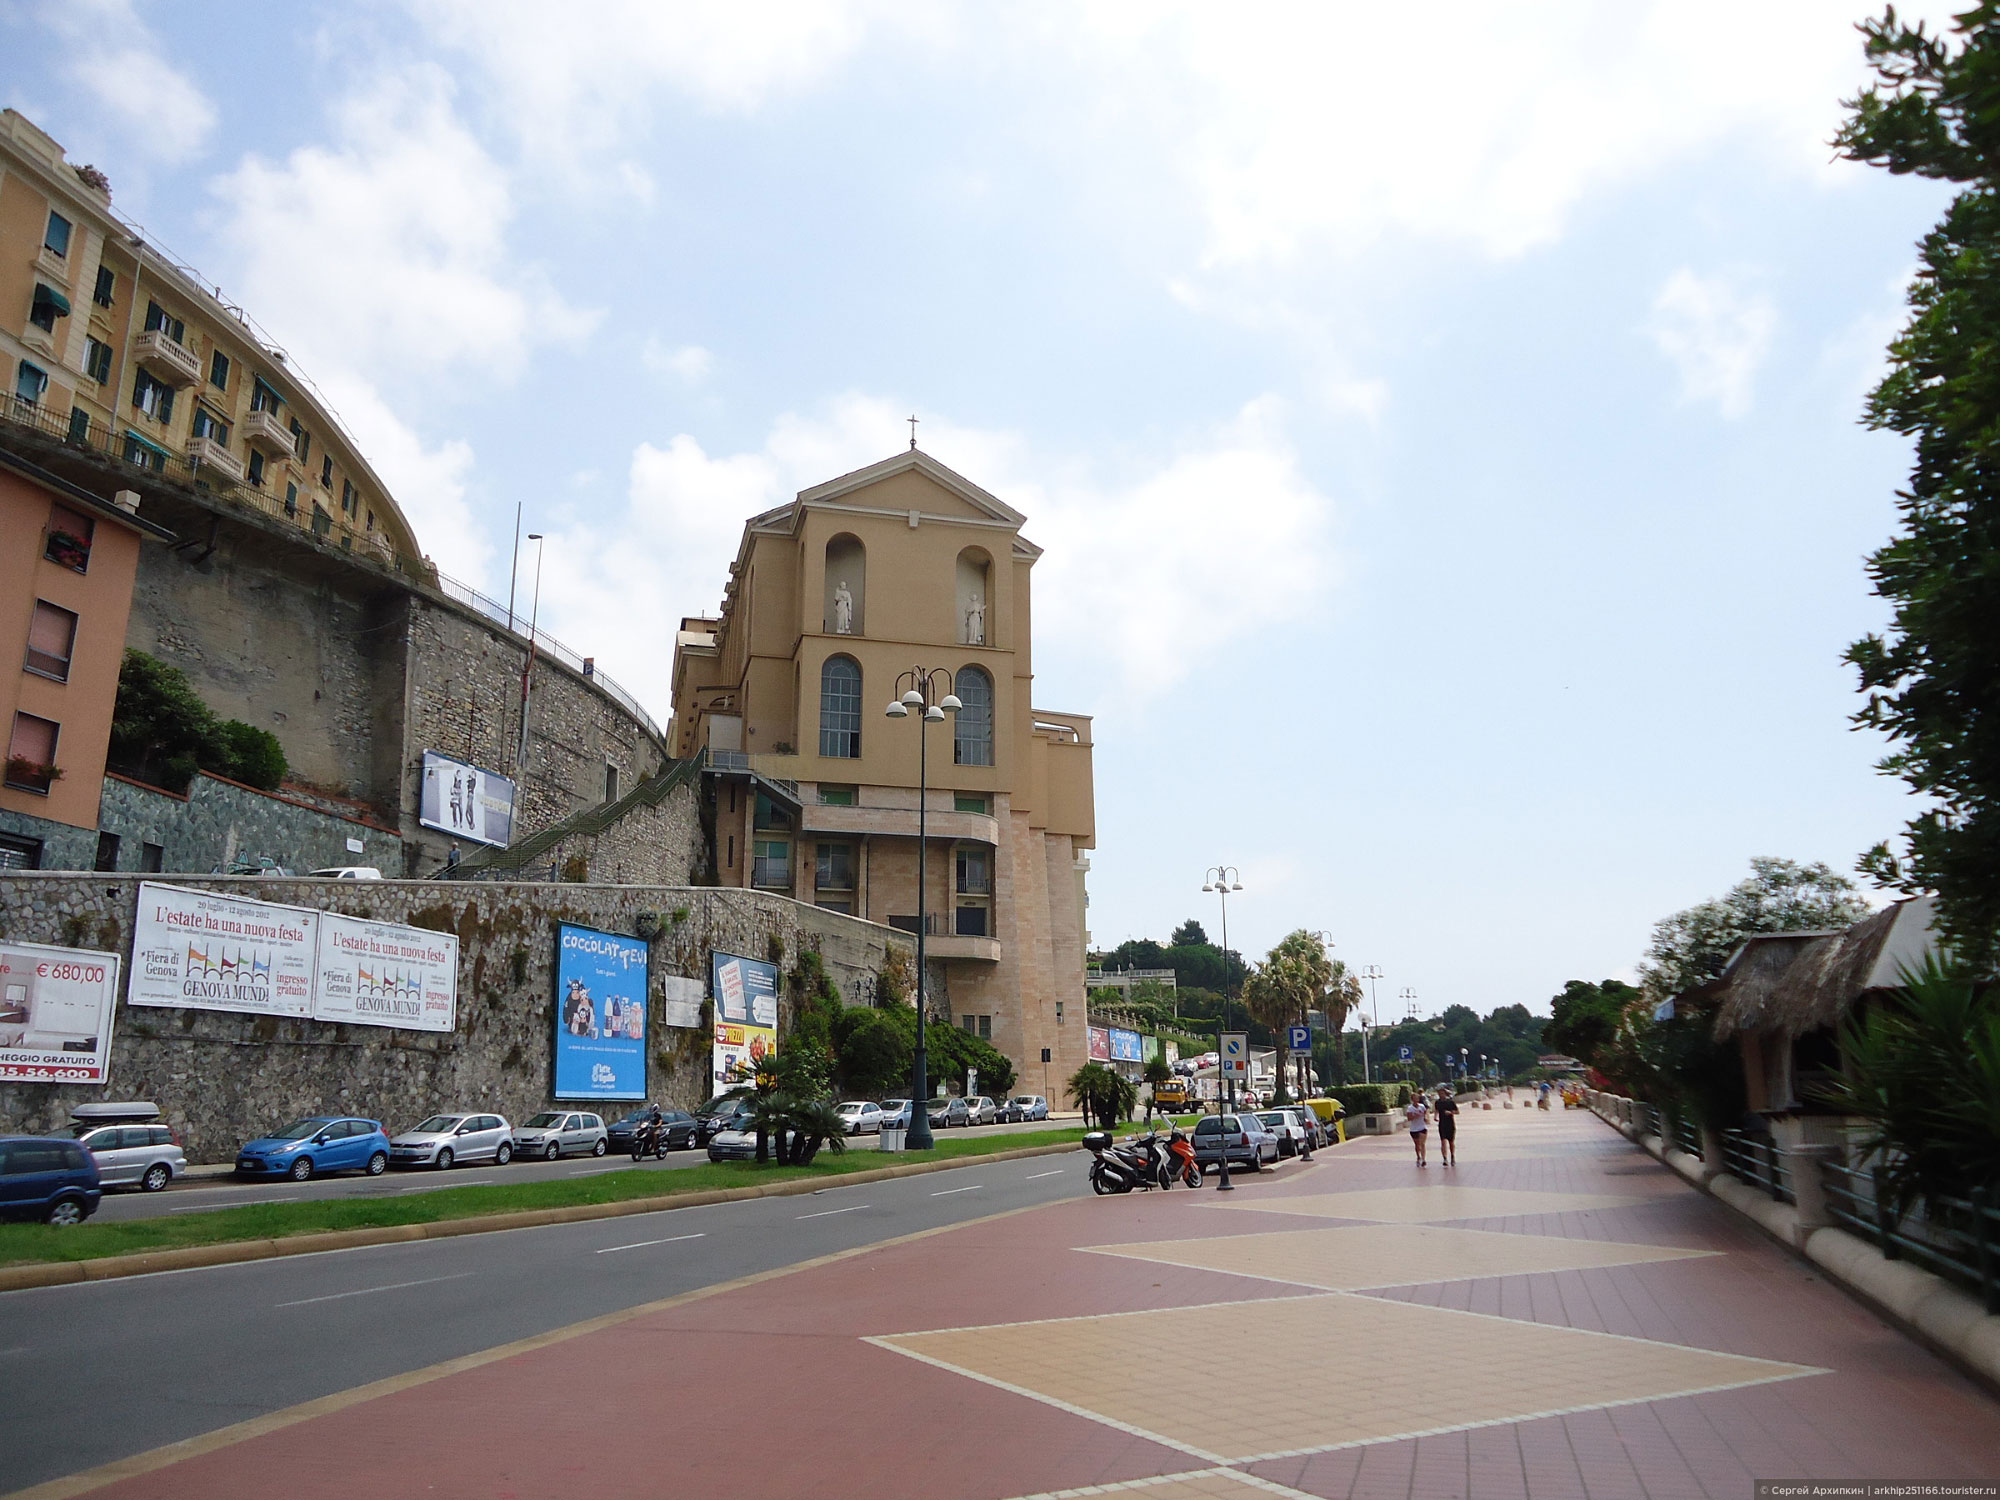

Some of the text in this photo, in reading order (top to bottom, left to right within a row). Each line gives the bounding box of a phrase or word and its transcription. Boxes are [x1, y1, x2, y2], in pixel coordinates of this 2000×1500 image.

[156, 906, 202, 928] L'estate
[205, 913, 218, 930] ha
[222, 920, 241, 933] una
[245, 924, 276, 938] nuova
[279, 924, 303, 942] festa
[333, 932, 368, 949] L'estate
[370, 938, 380, 952] ha
[382, 944, 398, 955] una
[401, 946, 425, 960] nuova
[427, 947, 446, 963] festa
[146, 950, 179, 964] Fiera di
[37, 963, 49, 977] €
[52, 964, 104, 984] 680,00
[146, 963, 177, 976] Genova
[327, 970, 344, 982] Fiera
[276, 971, 308, 984] ingresso
[183, 980, 230, 999] GENOVA
[276, 984, 307, 997] gratuito
[327, 982, 351, 993] Genova
[425, 988, 449, 1000] ingresso
[356, 996, 391, 1013] GENOVA
[425, 1000, 448, 1011] gratuito
[1293, 1029, 1307, 1047] P
[43, 1055, 96, 1065] GRATUITO
